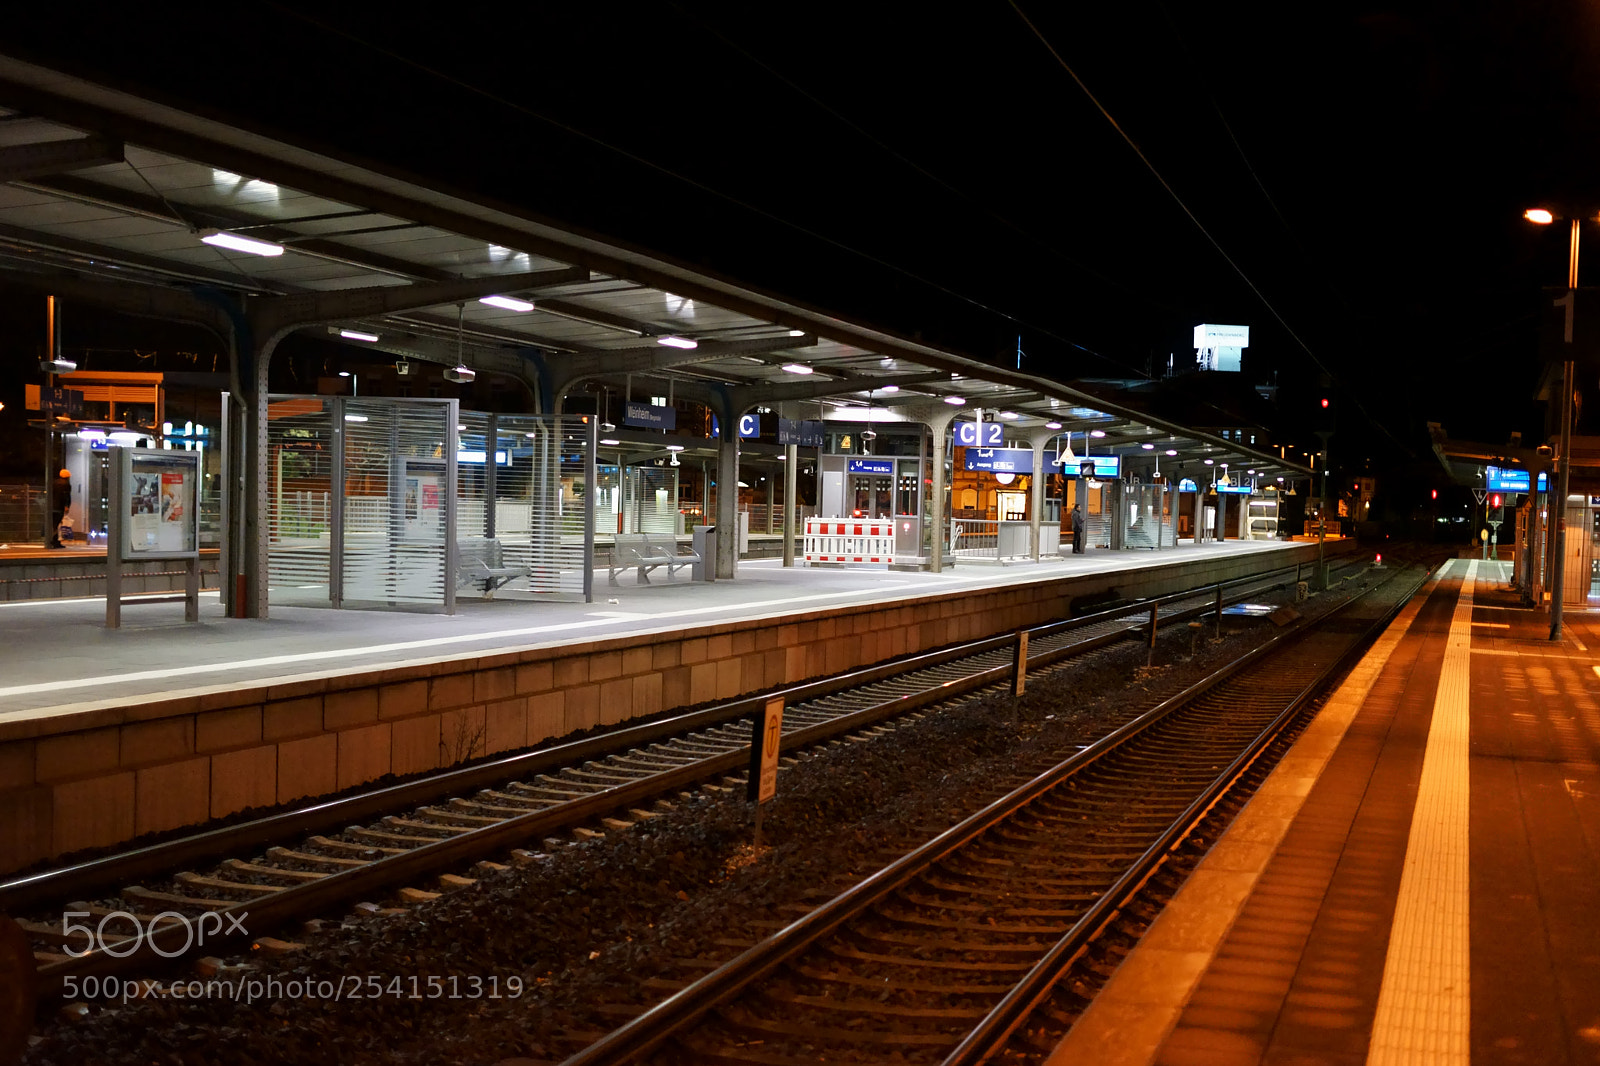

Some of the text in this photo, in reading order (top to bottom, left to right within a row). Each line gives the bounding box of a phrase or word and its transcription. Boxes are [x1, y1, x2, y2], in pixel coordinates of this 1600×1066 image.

[1553, 289, 1574, 343] 1
[627, 405, 650, 419] Weinheim
[740, 415, 754, 435] C
[960, 423, 1002, 443] C 2
